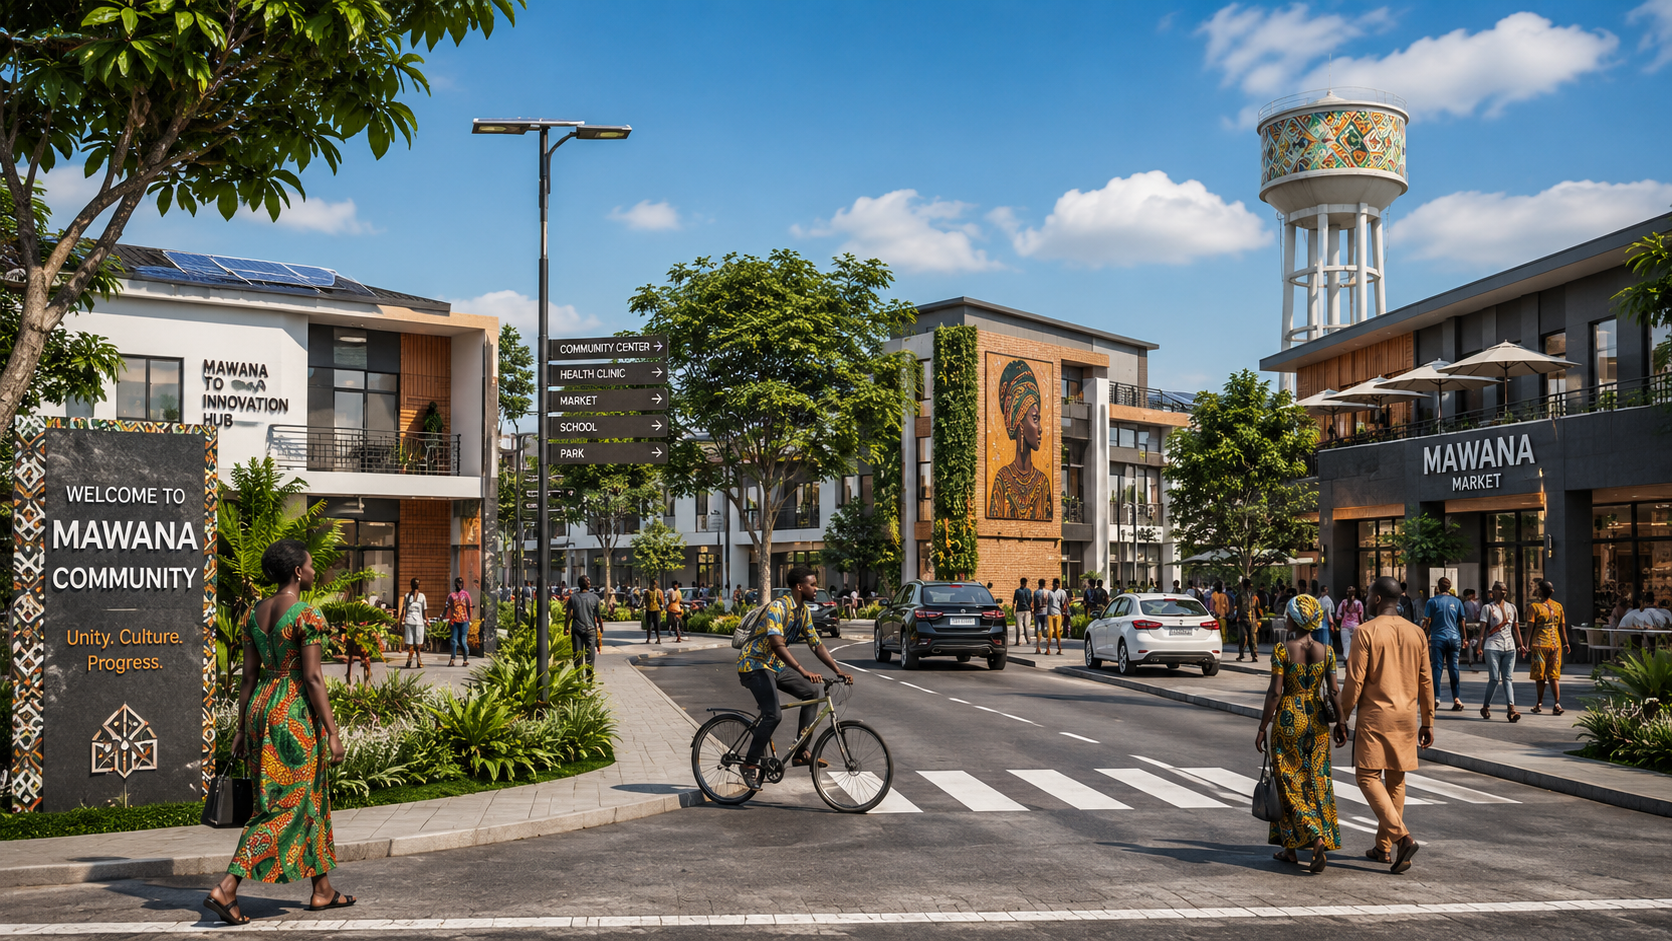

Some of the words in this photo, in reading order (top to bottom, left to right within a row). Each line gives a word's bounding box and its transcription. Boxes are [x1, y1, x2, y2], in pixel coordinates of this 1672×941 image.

[560, 343, 614, 353] COMMUNITY
[616, 342, 649, 352] CENTER
[204, 359, 268, 378] MAWANA
[560, 370, 594, 379] HEALTH
[597, 369, 625, 378] CLINIC
[205, 377, 224, 391] TO
[203, 394, 288, 412] INNOVATION
[560, 396, 597, 405] MARKET
[204, 413, 233, 427] HUB
[560, 423, 597, 432] SCHOOL
[560, 449, 584, 458] PARK
[1423, 434, 1535, 475] MAWANA
[1452, 473, 1501, 491] MARKET
[66, 486, 157, 503] WELCOME
[163, 488, 185, 504] TO
[52, 520, 198, 551] MAWANA
[52, 566, 197, 590] COMMUNITY
[67, 630, 114, 649] Unity.
[119, 629, 183, 646] Culture.
[88, 654, 163, 675] Progress.
